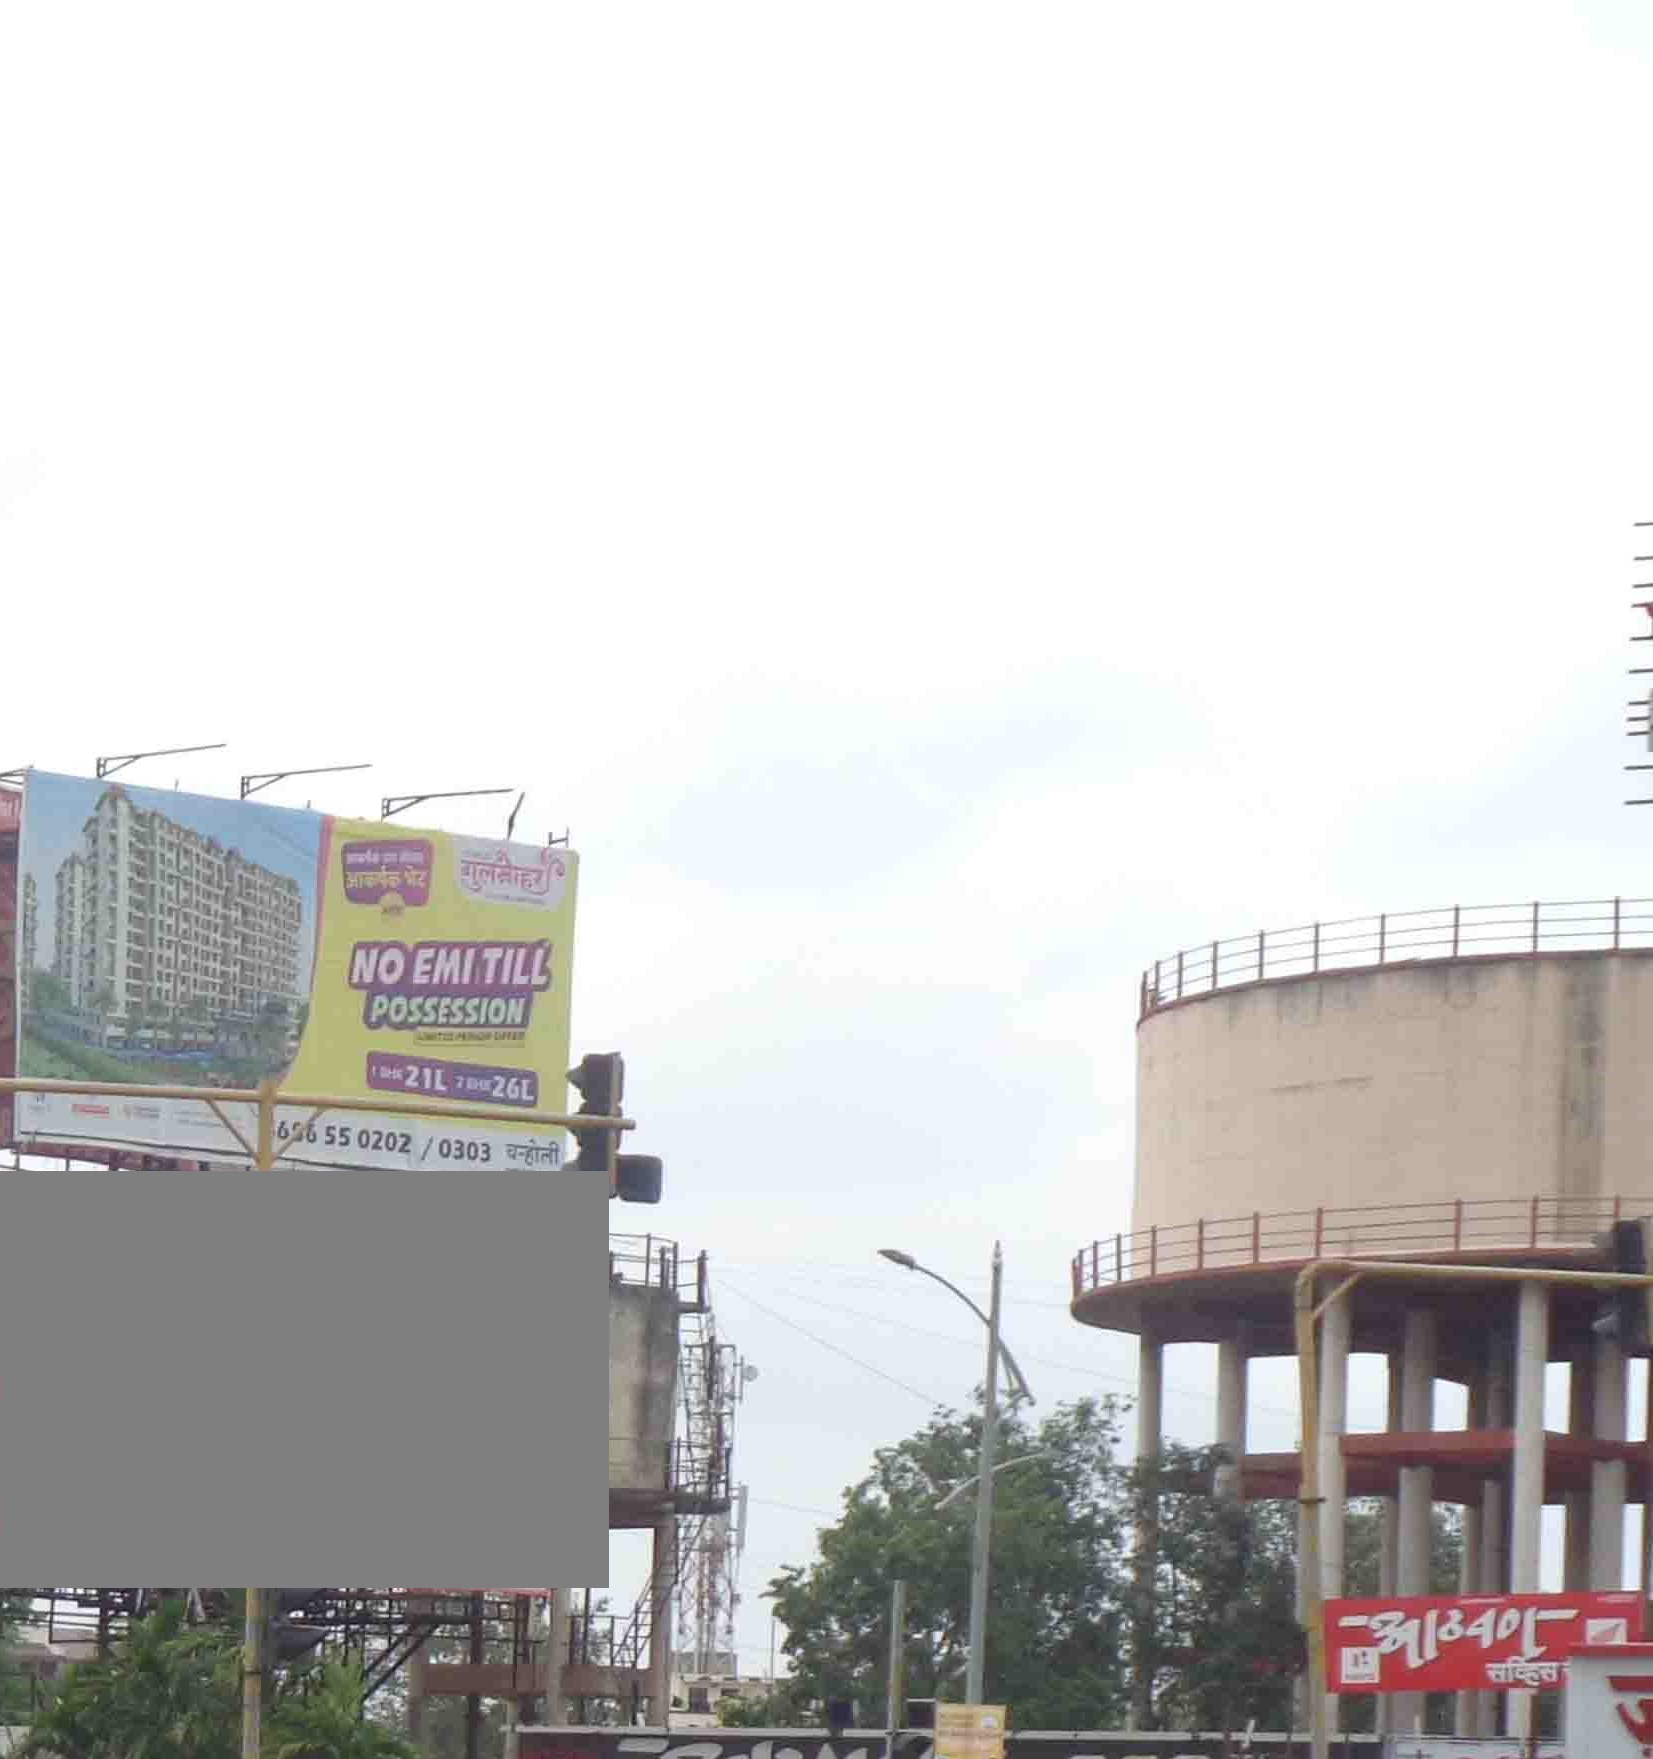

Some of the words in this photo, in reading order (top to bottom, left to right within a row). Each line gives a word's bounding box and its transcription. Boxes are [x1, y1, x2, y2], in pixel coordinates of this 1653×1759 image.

[350, 947, 404, 985] NO
[412, 947, 477, 986] EMI
[481, 945, 549, 986] TILL
[370, 995, 527, 1026] POSSESSION
[405, 1065, 448, 1091] 21L
[492, 1075, 535, 1100] 26L
[324, 1124, 351, 1147] 55
[357, 1129, 412, 1154] 0202
[438, 1137, 491, 1162] 0303
